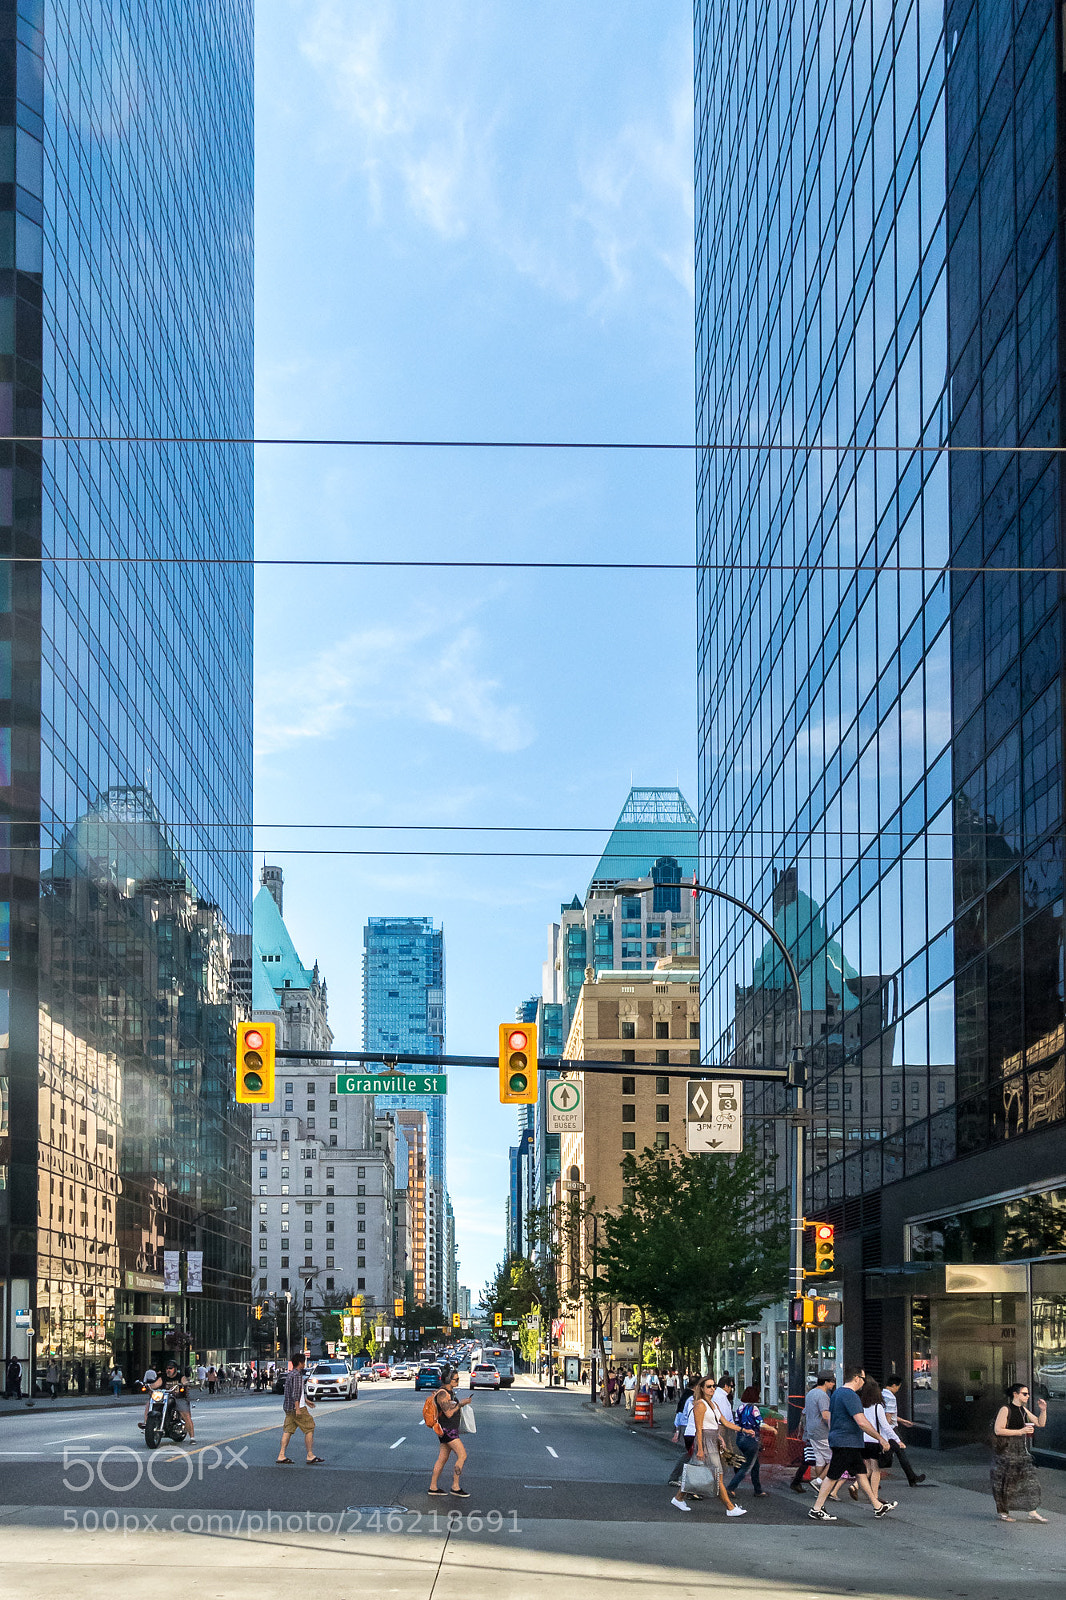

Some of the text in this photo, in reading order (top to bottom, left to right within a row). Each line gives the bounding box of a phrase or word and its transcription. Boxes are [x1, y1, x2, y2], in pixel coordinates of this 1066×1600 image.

[346, 1077, 438, 1092] Granville St
[724, 1099, 732, 1109] 3
[696, 1123, 712, 1131] 3PM
[716, 1123, 733, 1131] 7PM
